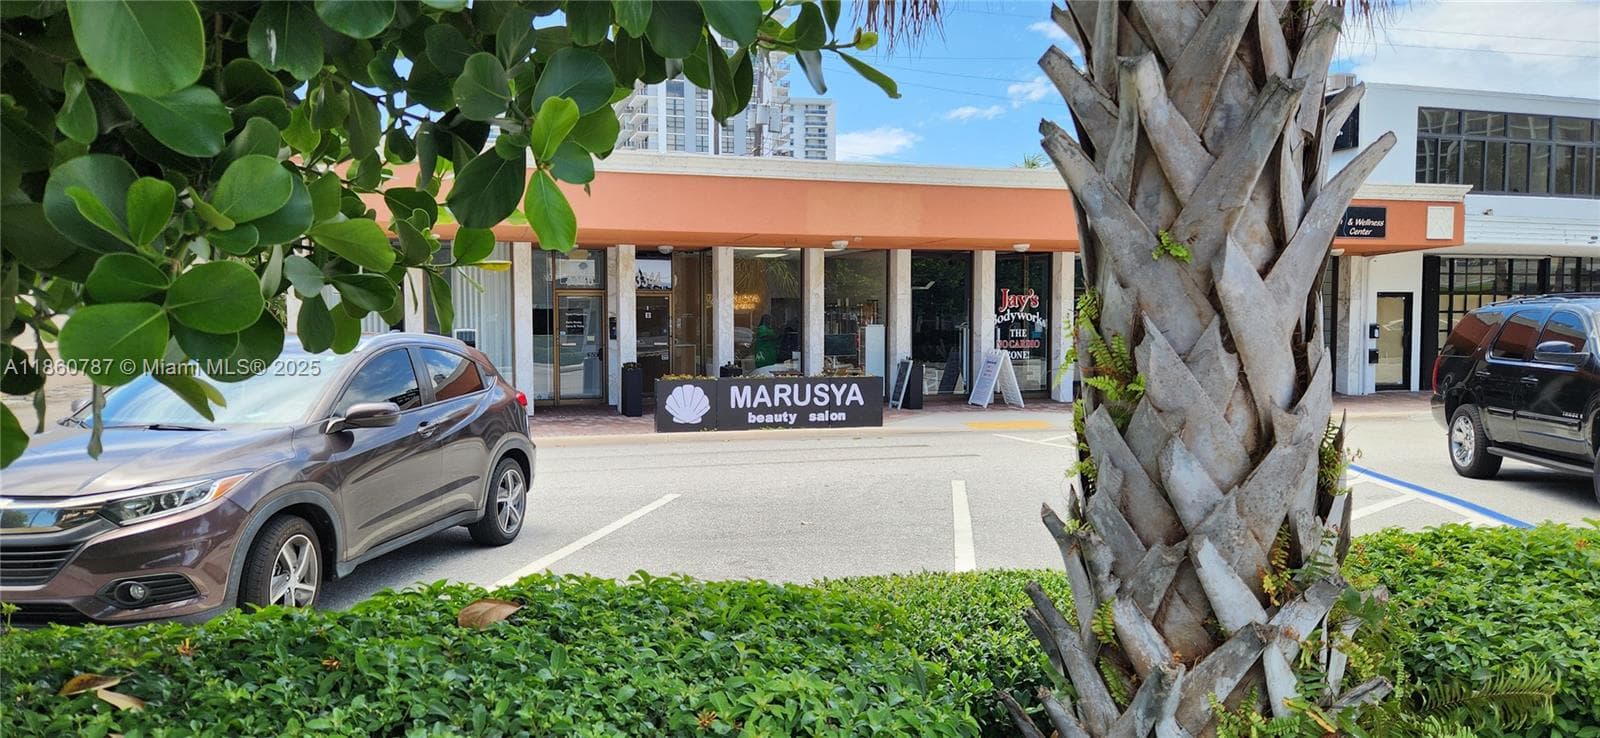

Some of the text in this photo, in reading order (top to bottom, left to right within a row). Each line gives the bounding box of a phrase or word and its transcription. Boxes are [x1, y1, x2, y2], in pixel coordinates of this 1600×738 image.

[1355, 218, 1384, 227] Wellness
[999, 288, 1039, 312] Jay's
[1009, 328, 1027, 338] THE
[996, 339, 1040, 348] NO CARDIO
[730, 383, 864, 408] MARUSYA
[748, 410, 846, 424] beauty salon
